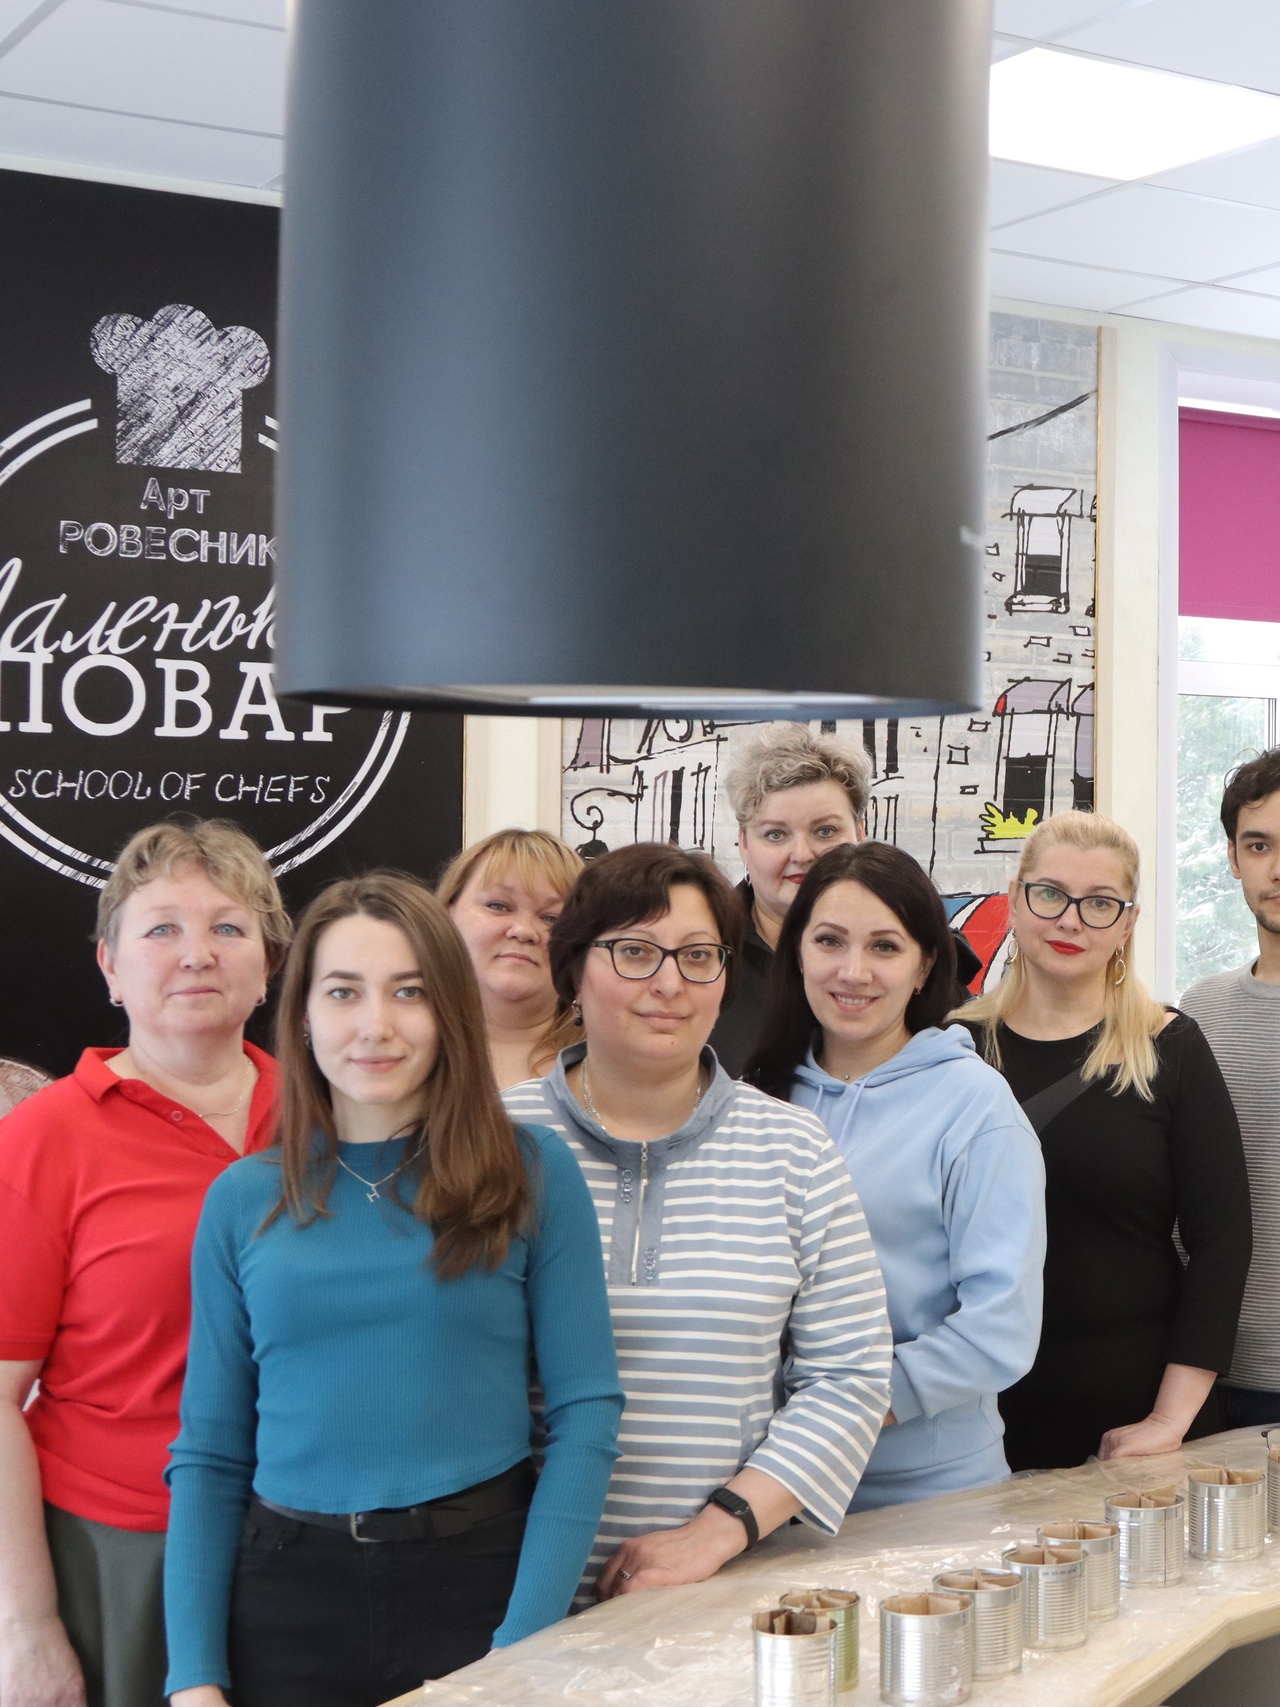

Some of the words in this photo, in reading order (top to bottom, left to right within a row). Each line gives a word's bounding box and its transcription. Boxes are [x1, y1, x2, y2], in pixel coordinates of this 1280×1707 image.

[140, 477, 211, 519] Арт
[59, 520, 278, 567] РОВЕСНИК
[9, 769, 151, 800] SCHOOL
[160, 771, 206, 800] OF
[215, 773, 330, 804] CHEFS
